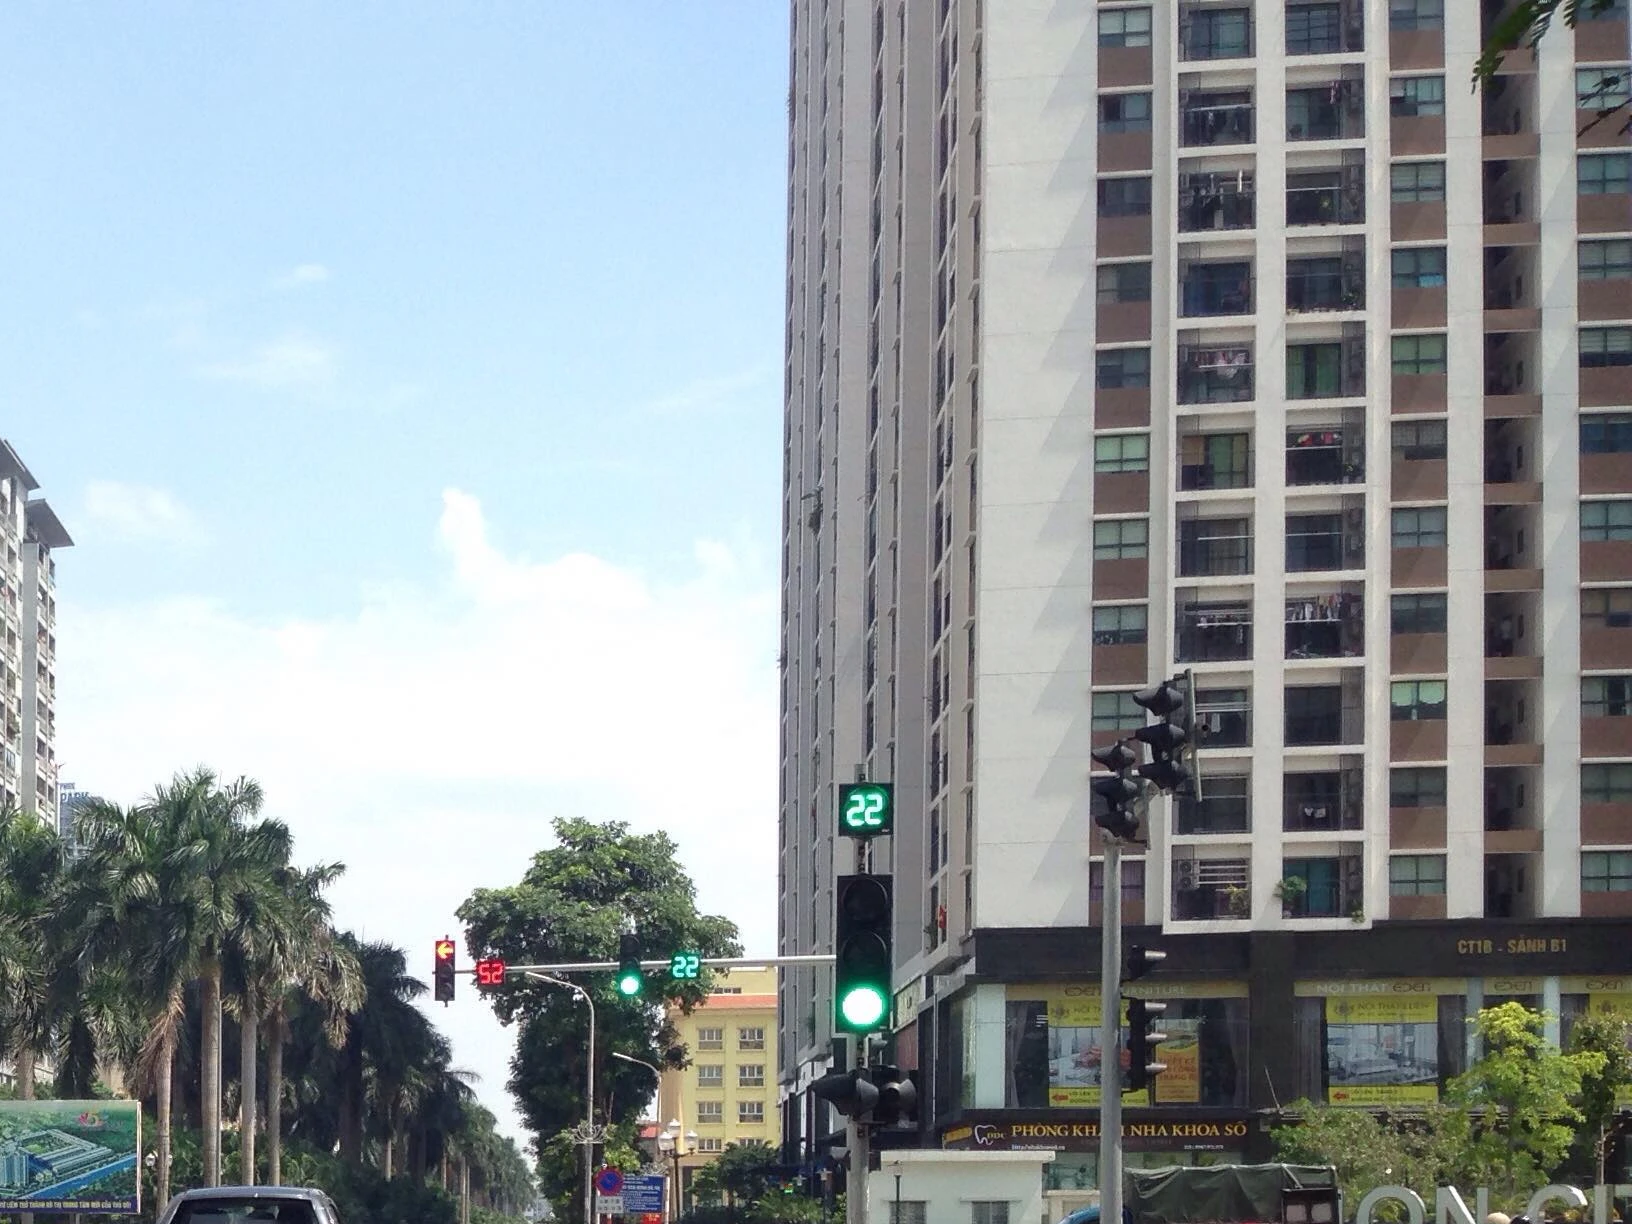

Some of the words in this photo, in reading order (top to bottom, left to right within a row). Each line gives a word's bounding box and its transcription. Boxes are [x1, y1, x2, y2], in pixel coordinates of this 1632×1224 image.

[846, 793, 883, 827] 22
[1457, 939, 1493, 954] CT1B
[1507, 934, 1546, 953] SẢNH
[1550, 938, 1567, 952] B1
[478, 963, 503, 984] 52
[672, 956, 699, 978] 22
[1120, 985, 1186, 996] URNITURE
[1011, 1121, 1068, 1137] PHÒNG
[1130, 1124, 1168, 1137] NHA
[1171, 1123, 1221, 1137] KHOA
